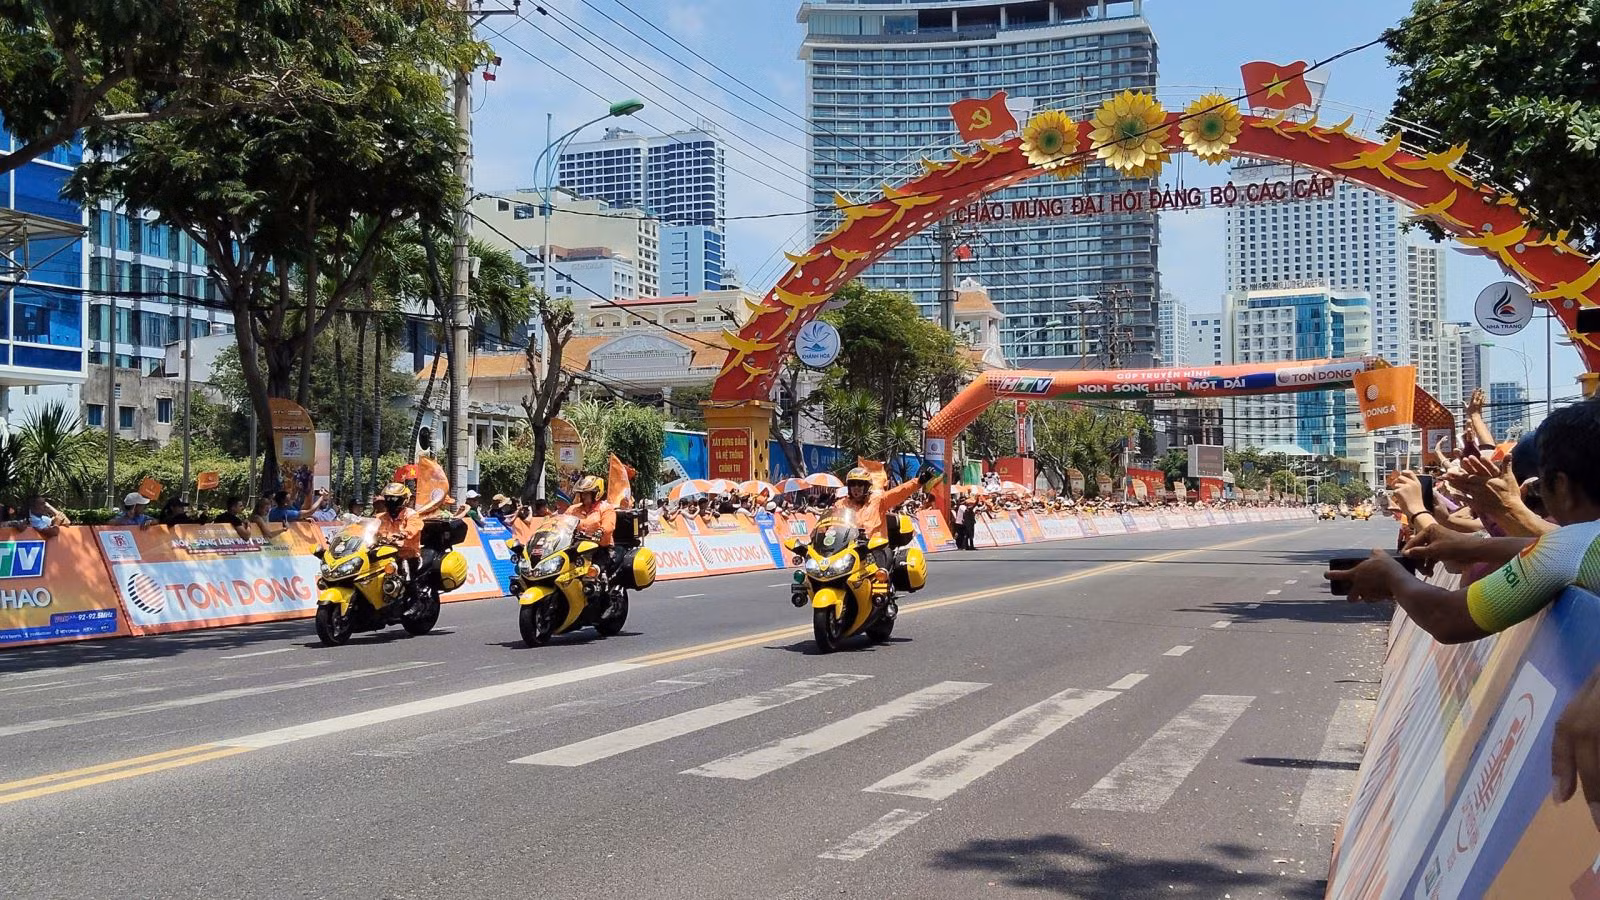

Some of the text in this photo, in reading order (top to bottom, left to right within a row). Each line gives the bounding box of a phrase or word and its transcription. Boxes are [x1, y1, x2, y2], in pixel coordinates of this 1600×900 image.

[1012, 197, 1063, 219] MỪNG
[1111, 189, 1143, 214] HỘI
[1149, 183, 1201, 210] ĐẢNG
[1210, 181, 1237, 207] BỘ
[1247, 178, 1286, 202] CÁC
[1295, 172, 1335, 198] CẤP
[1292, 373, 1316, 383] TON
[1318, 369, 1352, 381] DONG
[999, 377, 1053, 393] HTV
[1077, 384, 1108, 393] NON
[1112, 382, 1150, 393] SÔNG
[1187, 380, 1217, 392] MỘT
[1367, 407, 1390, 417] DONG
[1390, 404, 1397, 413] A
[711, 547, 734, 563] TON
[733, 545, 760, 562] DONG
[165, 575, 312, 611] TON DONG
